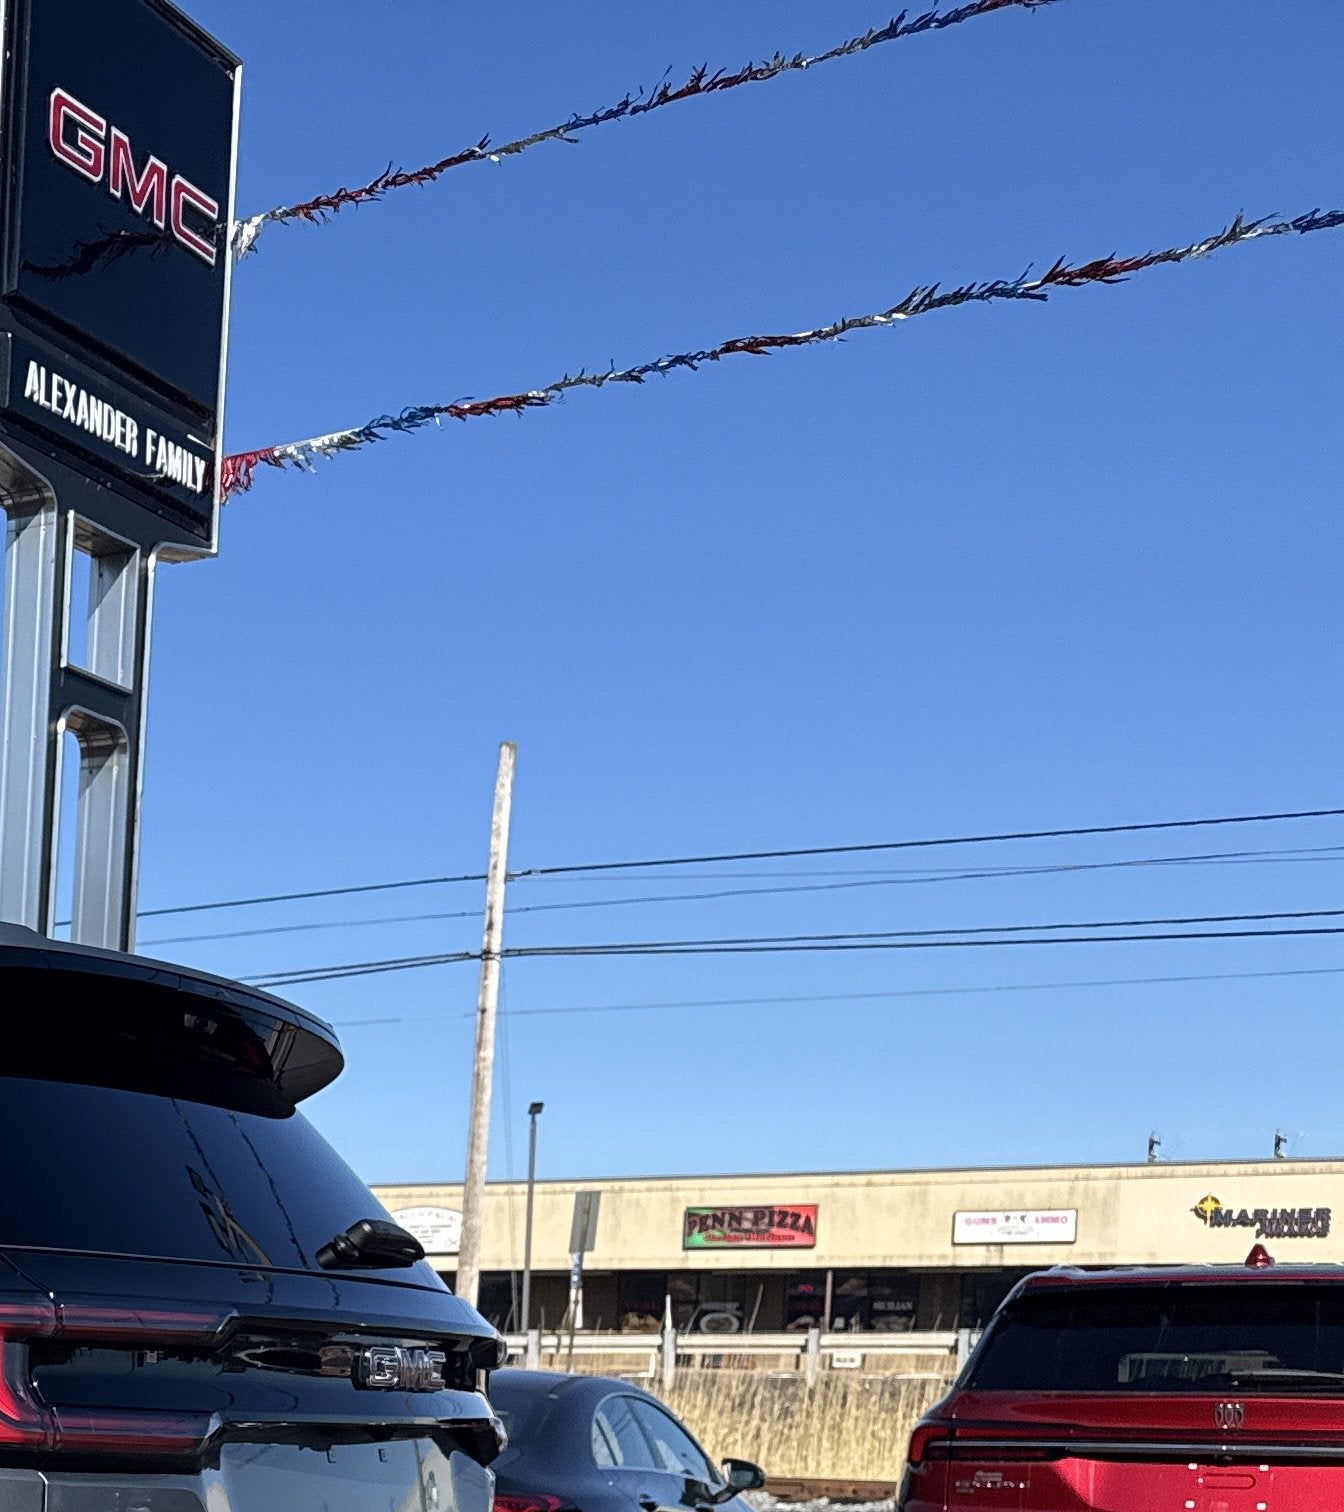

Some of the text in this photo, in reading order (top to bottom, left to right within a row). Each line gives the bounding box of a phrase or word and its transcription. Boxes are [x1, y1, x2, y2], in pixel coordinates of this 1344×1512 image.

[49, 87, 219, 267] GMC
[24, 360, 207, 494] ALEXANDER FAMILY
[687, 1210, 814, 1237] PENN PIZZA
[1210, 1207, 1332, 1228] MARINER
[369, 1346, 447, 1390] GMC
